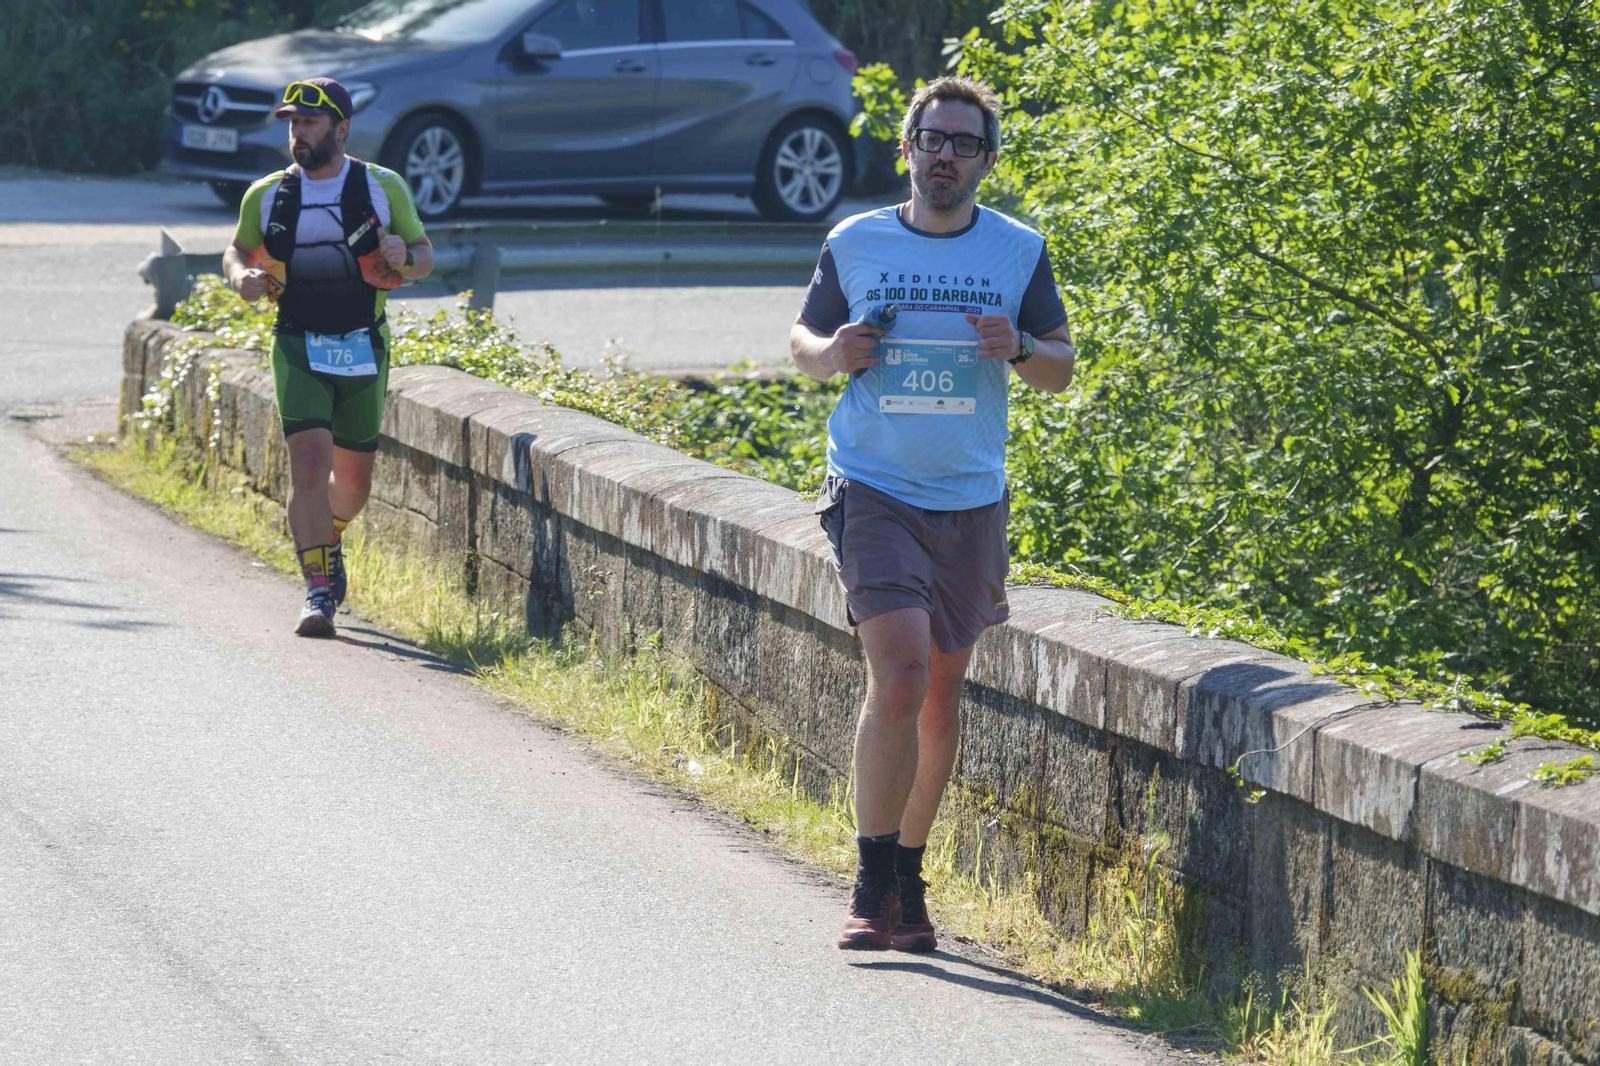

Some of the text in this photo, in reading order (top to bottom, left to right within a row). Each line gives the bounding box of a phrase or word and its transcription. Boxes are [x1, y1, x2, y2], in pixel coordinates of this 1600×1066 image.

[880, 272, 990, 288] X EDICIÓN
[885, 287, 905, 301] 100
[910, 288, 928, 301] DO
[932, 289, 1002, 308] BARBANZA
[924, 304, 961, 312] CARAMINAL
[965, 306, 981, 314] 2025
[326, 348, 353, 365] 176
[958, 354, 969, 363] 26
[902, 370, 954, 393] 406
